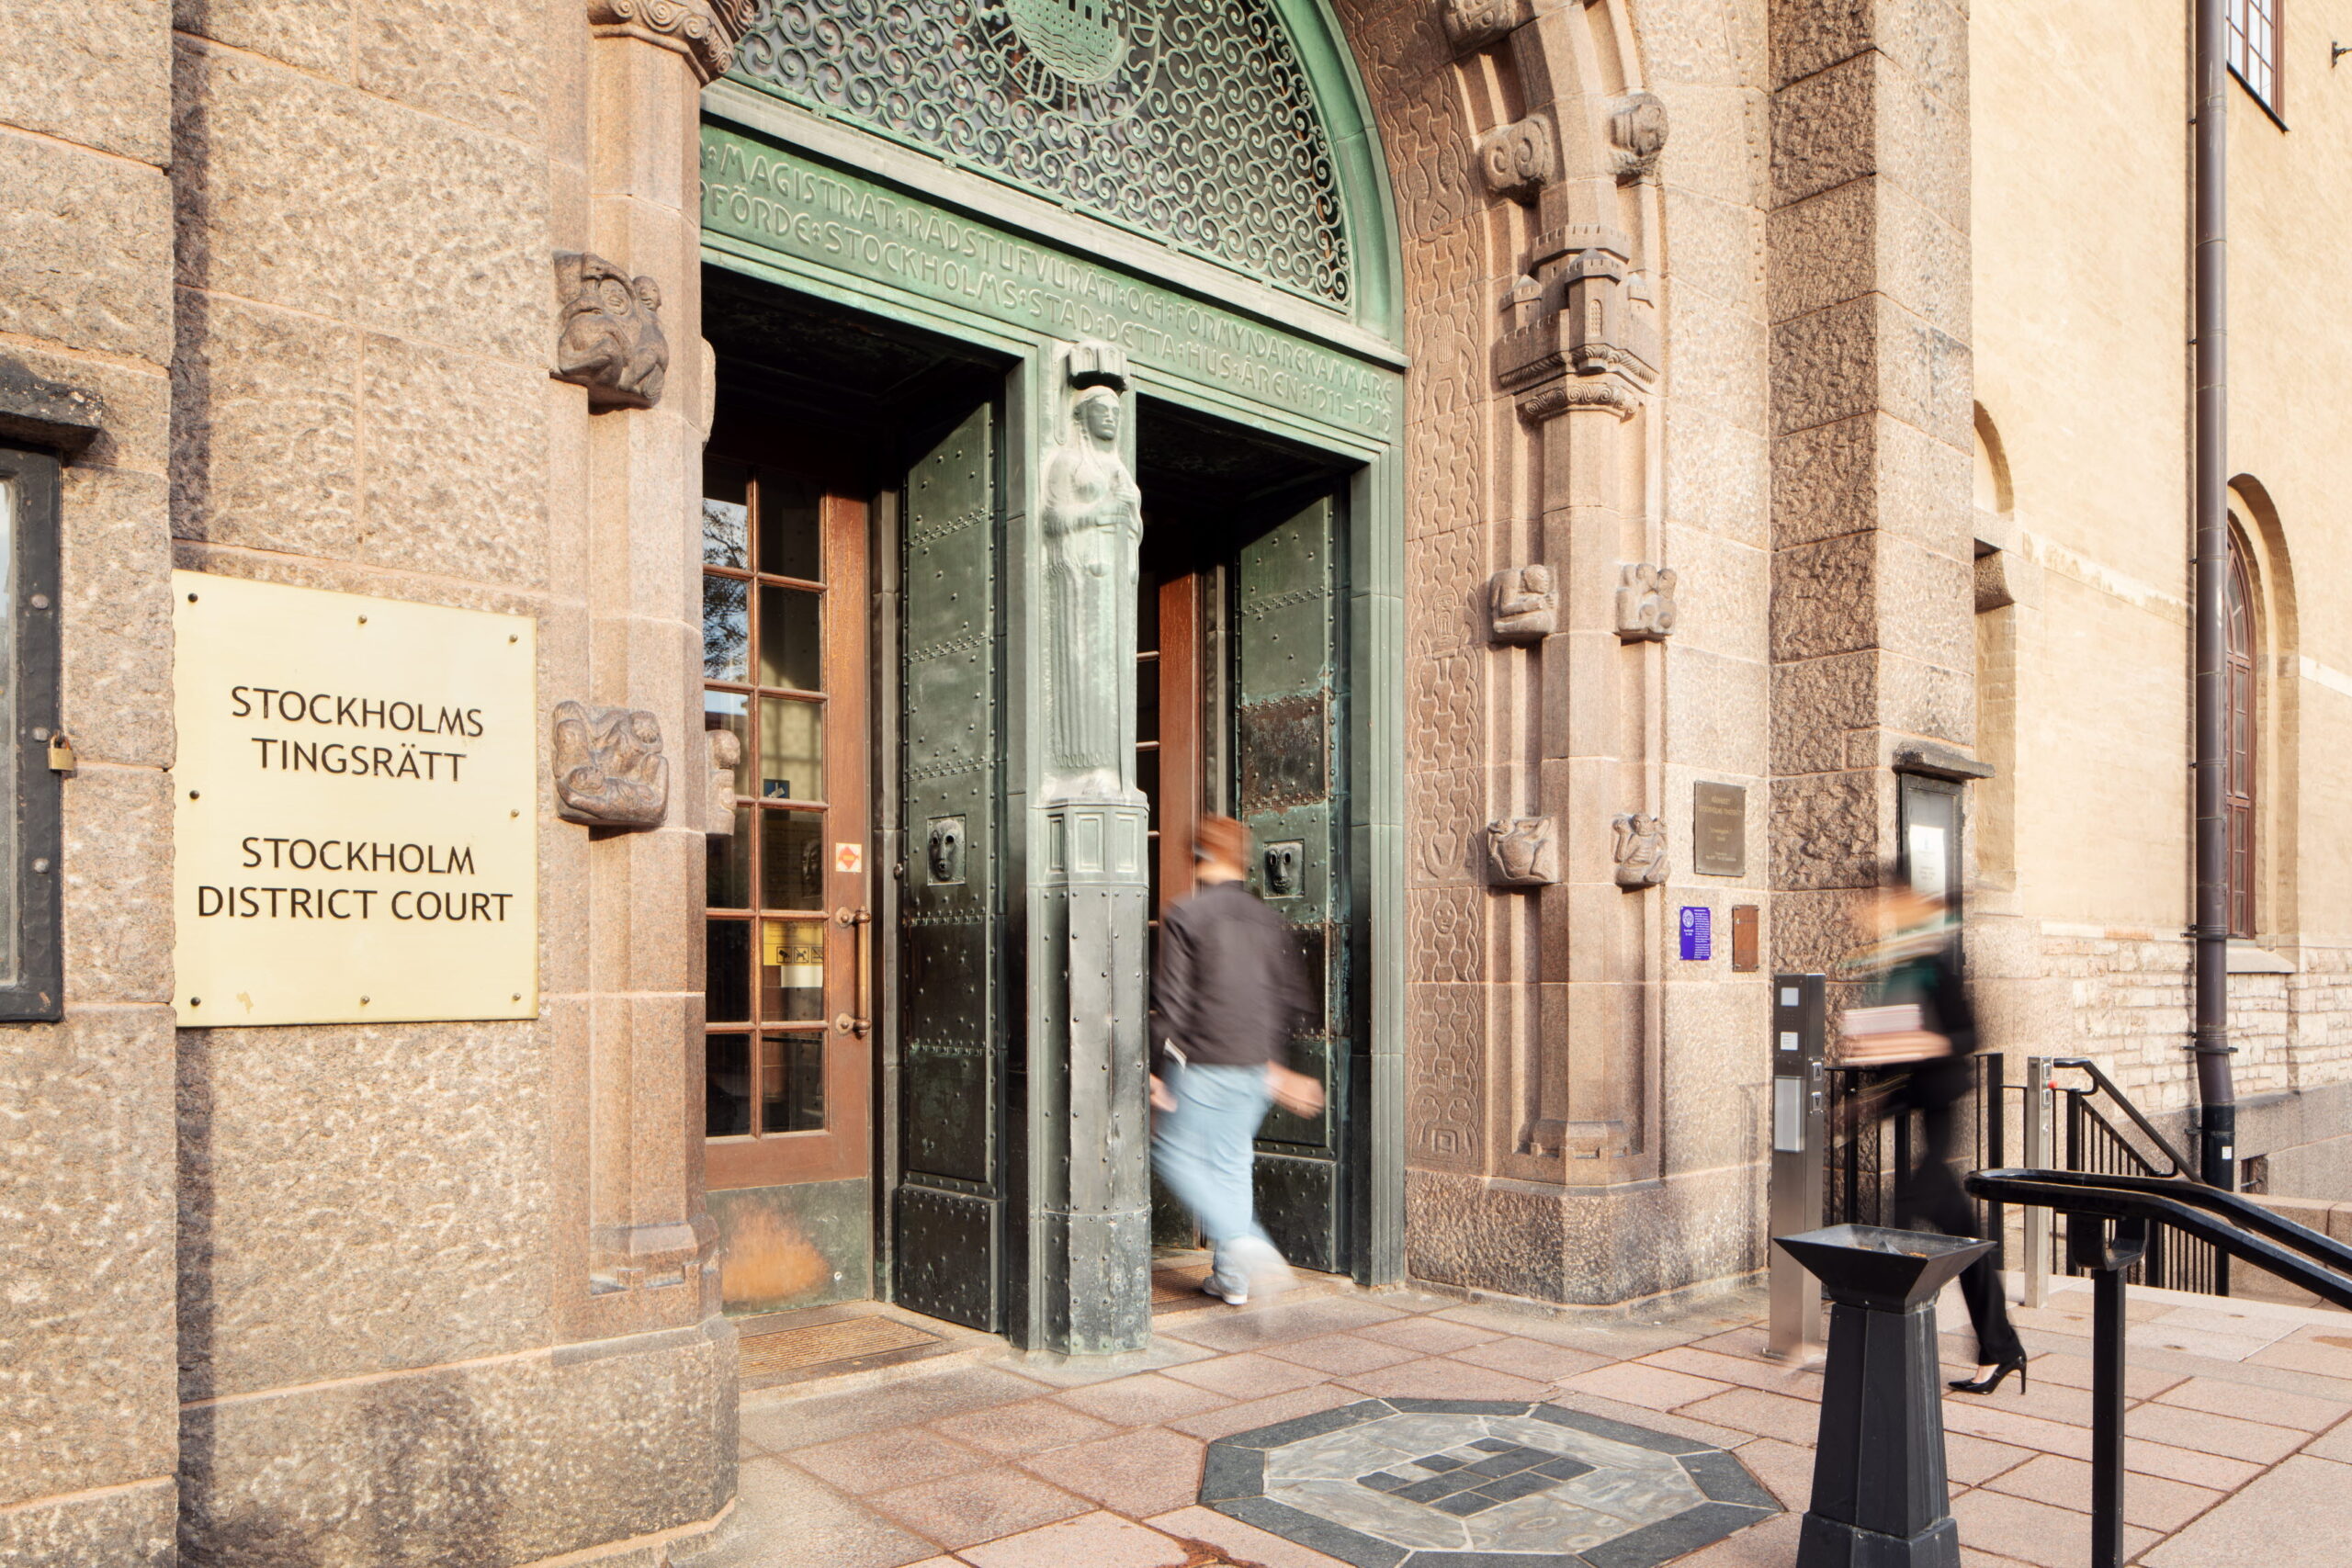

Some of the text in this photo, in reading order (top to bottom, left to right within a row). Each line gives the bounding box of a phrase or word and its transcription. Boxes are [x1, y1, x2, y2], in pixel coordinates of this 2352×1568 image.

[720, 142, 1393, 404] MAGISTRAT RÅDSTUFVURÄTT OCH FÖRMYNDAREKAMMARE
[825, 220, 1018, 310] STOCKHOLMS
[1028, 288, 1094, 333] STAD
[1105, 313, 1176, 362] DETTA
[1186, 340, 1231, 379] HUS
[1241, 355, 1299, 403] ÅREN
[231, 685, 484, 738] STOCKHOLMS
[251, 737, 467, 782] TINGSRÄTT
[241, 836, 476, 875] STOCKHOLM
[198, 885, 514, 922] DISTRICT COURT
